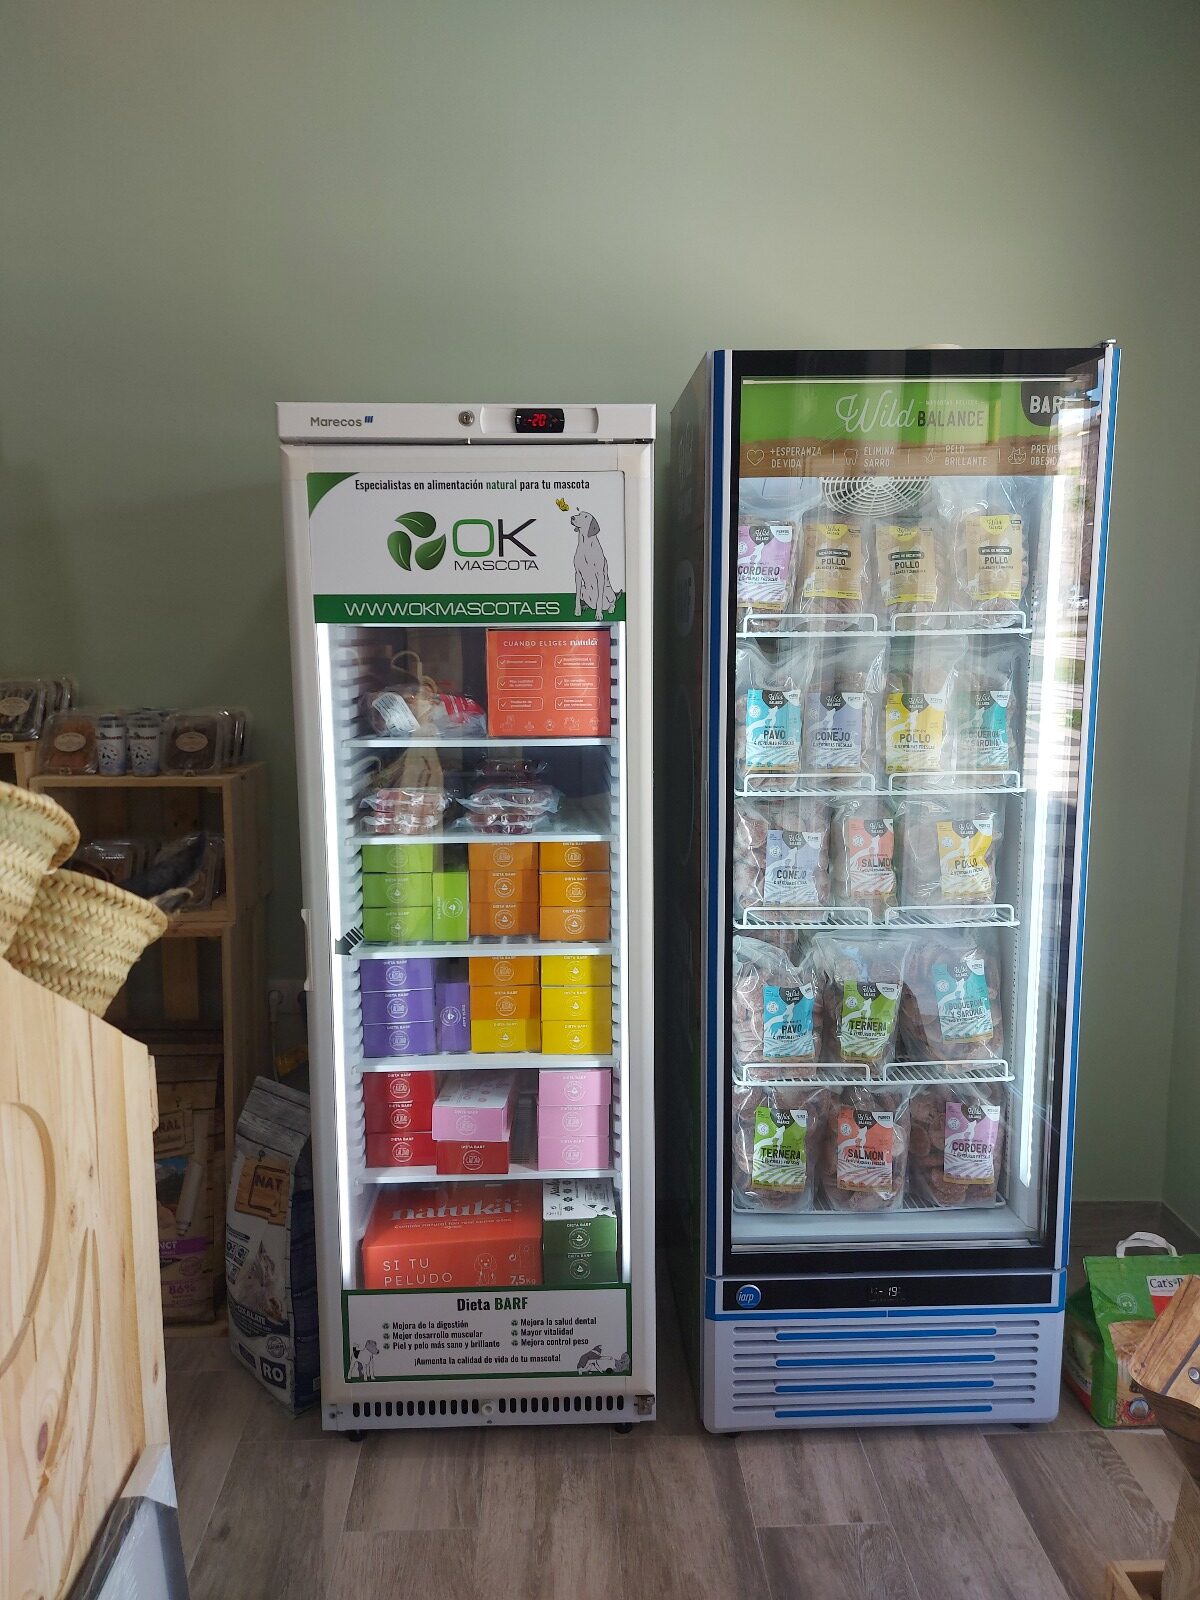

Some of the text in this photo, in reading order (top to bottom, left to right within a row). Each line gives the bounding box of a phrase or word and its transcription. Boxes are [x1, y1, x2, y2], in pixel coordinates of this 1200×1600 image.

[835, 389, 917, 433] Wild
[310, 416, 362, 427] Marecos
[917, 410, 985, 428] BALANCE
[863, 446, 895, 456] ELIMINA
[945, 445, 965, 454] PELO
[771, 458, 801, 468] DE VIDA
[863, 458, 890, 467] SARRO
[944, 456, 988, 466] BRILLANTE
[355, 479, 590, 493] Especialistas en alimentación natural para tu mascota
[452, 518, 537, 558] OK
[454, 560, 539, 571] MASCOTA
[821, 558, 846, 566] POLLO
[894, 561, 920, 569] POLLO
[984, 556, 1008, 565] POLLO
[737, 566, 780, 576] CORDERO
[343, 601, 561, 617] WWW.OKMASCOTA.ES
[763, 730, 786, 740] PAVO
[815, 731, 851, 741] CONEJO
[899, 733, 931, 743] POLLO
[776, 869, 807, 879] CONEJO
[781, 1024, 802, 1034] PAVO
[849, 1020, 887, 1031] TERNERA
[952, 1142, 992, 1154] CORDERO
[761, 1148, 801, 1160] TERNERA
[383, 1258, 430, 1272] SI TU
[384, 1272, 453, 1287] PELUDO
[738, 1291, 754, 1303] iarp
[457, 1297, 528, 1311] Dieta BARF
[428, 1321, 435, 1329] la
[437, 1320, 469, 1330] digestión
[520, 1317, 597, 1327] Mejora la salud dental
[392, 1332, 412, 1341] Mejor
[451, 1330, 483, 1338] muscular
[520, 1328, 574, 1337] Mayor vitalidad
[393, 1342, 406, 1350] Piel
[430, 1341, 445, 1349] más
[470, 1340, 500, 1348] brillante
[520, 1338, 589, 1347] Mejora control peso
[448, 1356, 456, 1364] la
[457, 1356, 482, 1364] calidad
[484, 1356, 493, 1364] de
[494, 1355, 509, 1364] vida
[510, 1355, 519, 1363] de
[520, 1355, 528, 1363] tu
[529, 1354, 561, 1362] mascota!
[262, 1362, 285, 1382] RO
